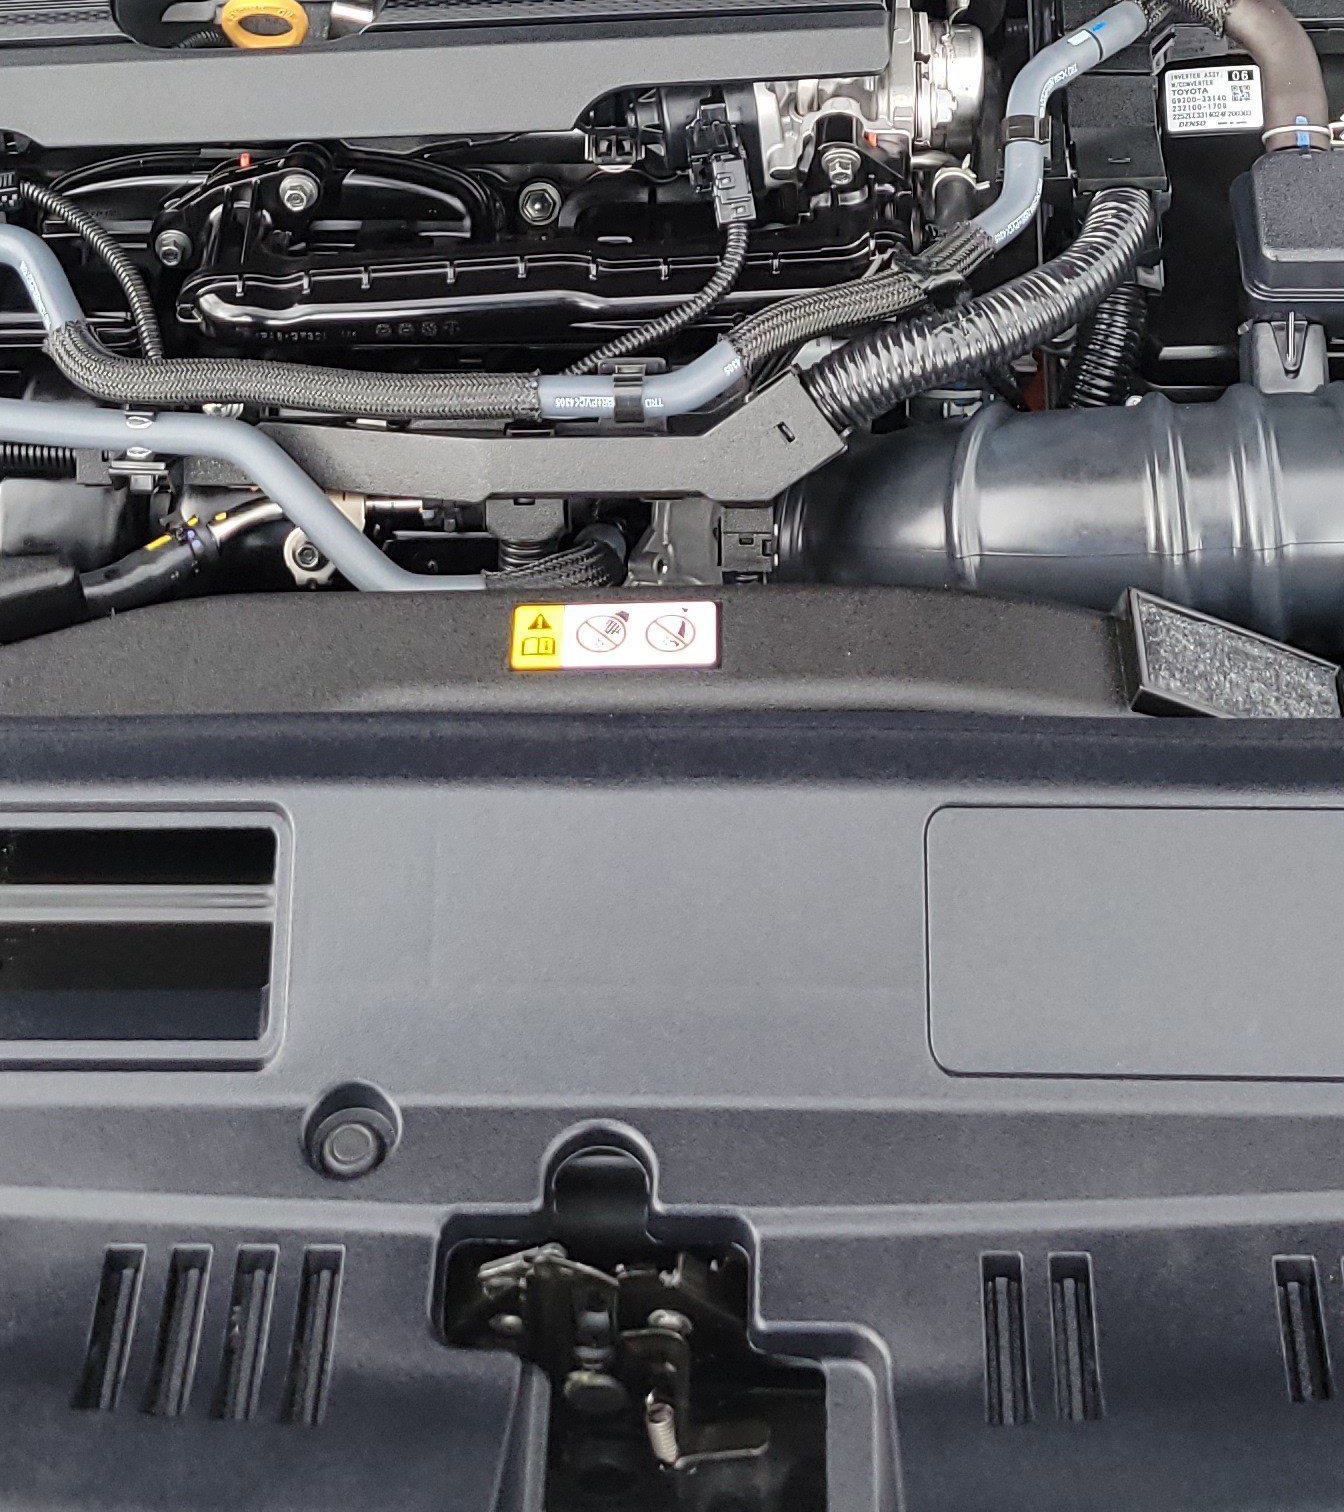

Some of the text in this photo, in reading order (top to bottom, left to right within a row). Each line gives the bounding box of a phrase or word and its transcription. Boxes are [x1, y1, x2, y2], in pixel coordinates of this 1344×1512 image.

[1231, 70, 1249, 81] 06
[1171, 87, 1209, 96] TOYOTA
[1178, 120, 1207, 128] DENSO
